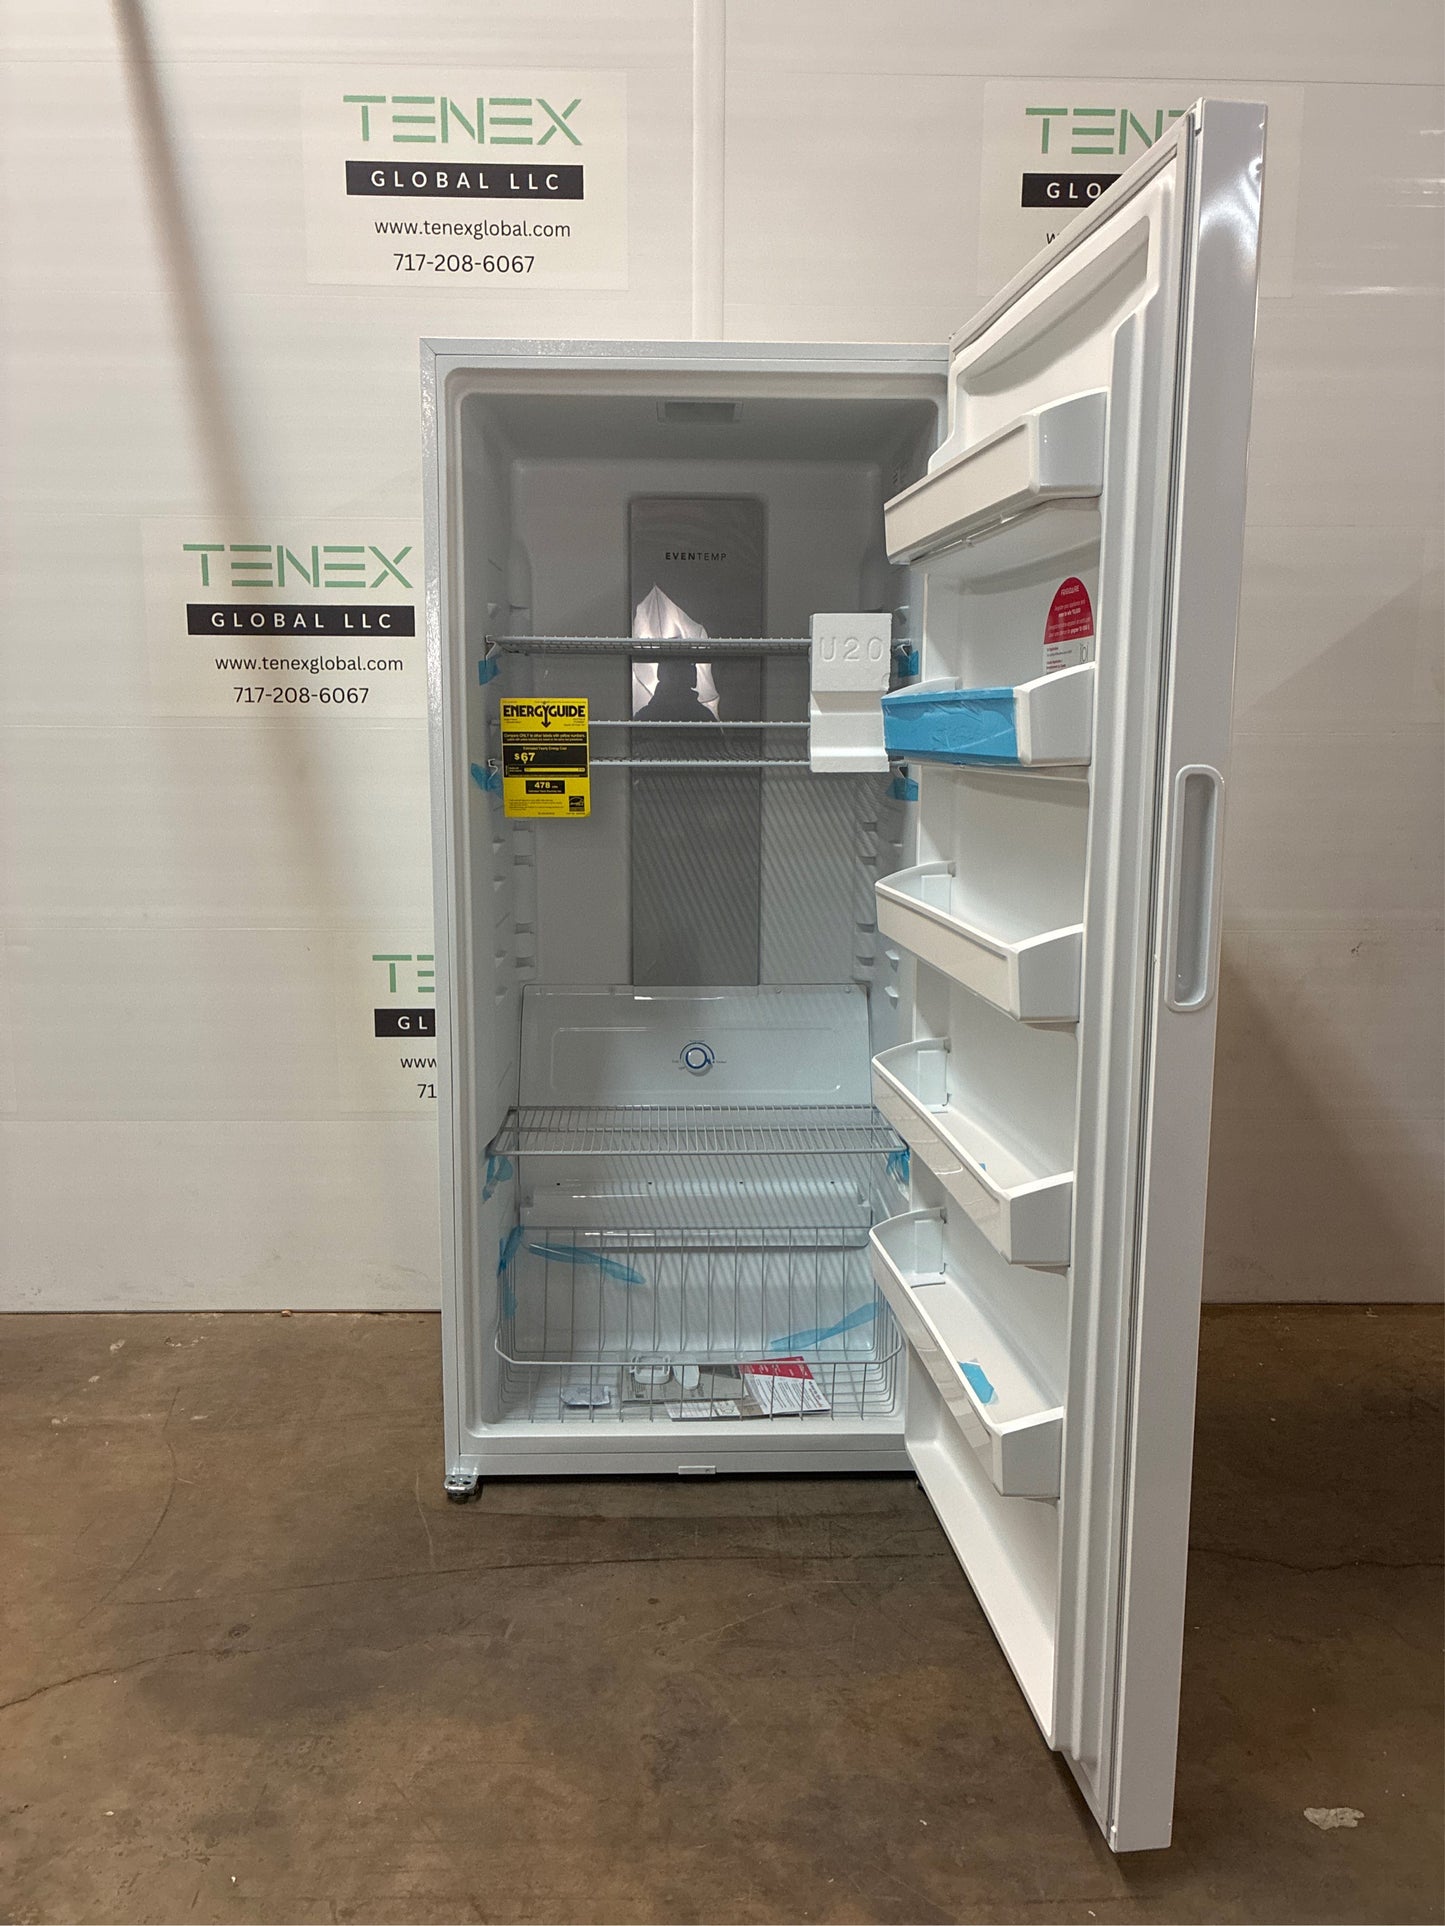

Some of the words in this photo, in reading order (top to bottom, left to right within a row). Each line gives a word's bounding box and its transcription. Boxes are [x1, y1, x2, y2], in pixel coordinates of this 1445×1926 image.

[343, 95, 582, 145] TENEX
[371, 170, 489, 190] GLOBAL
[510, 173, 559, 190] LLC
[374, 219, 571, 240] www.tenexglobal.com
[392, 253, 535, 273] 717-208-6067
[183, 544, 414, 589] TENEX
[665, 552, 727, 561] EVENTEMP
[211, 612, 325, 629] GLOBAL
[344, 613, 392, 629] LLC
[818, 636, 884, 662] U20
[215, 656, 404, 674] www.tenexglobal.com
[233, 687, 369, 704] 717-208-6067
